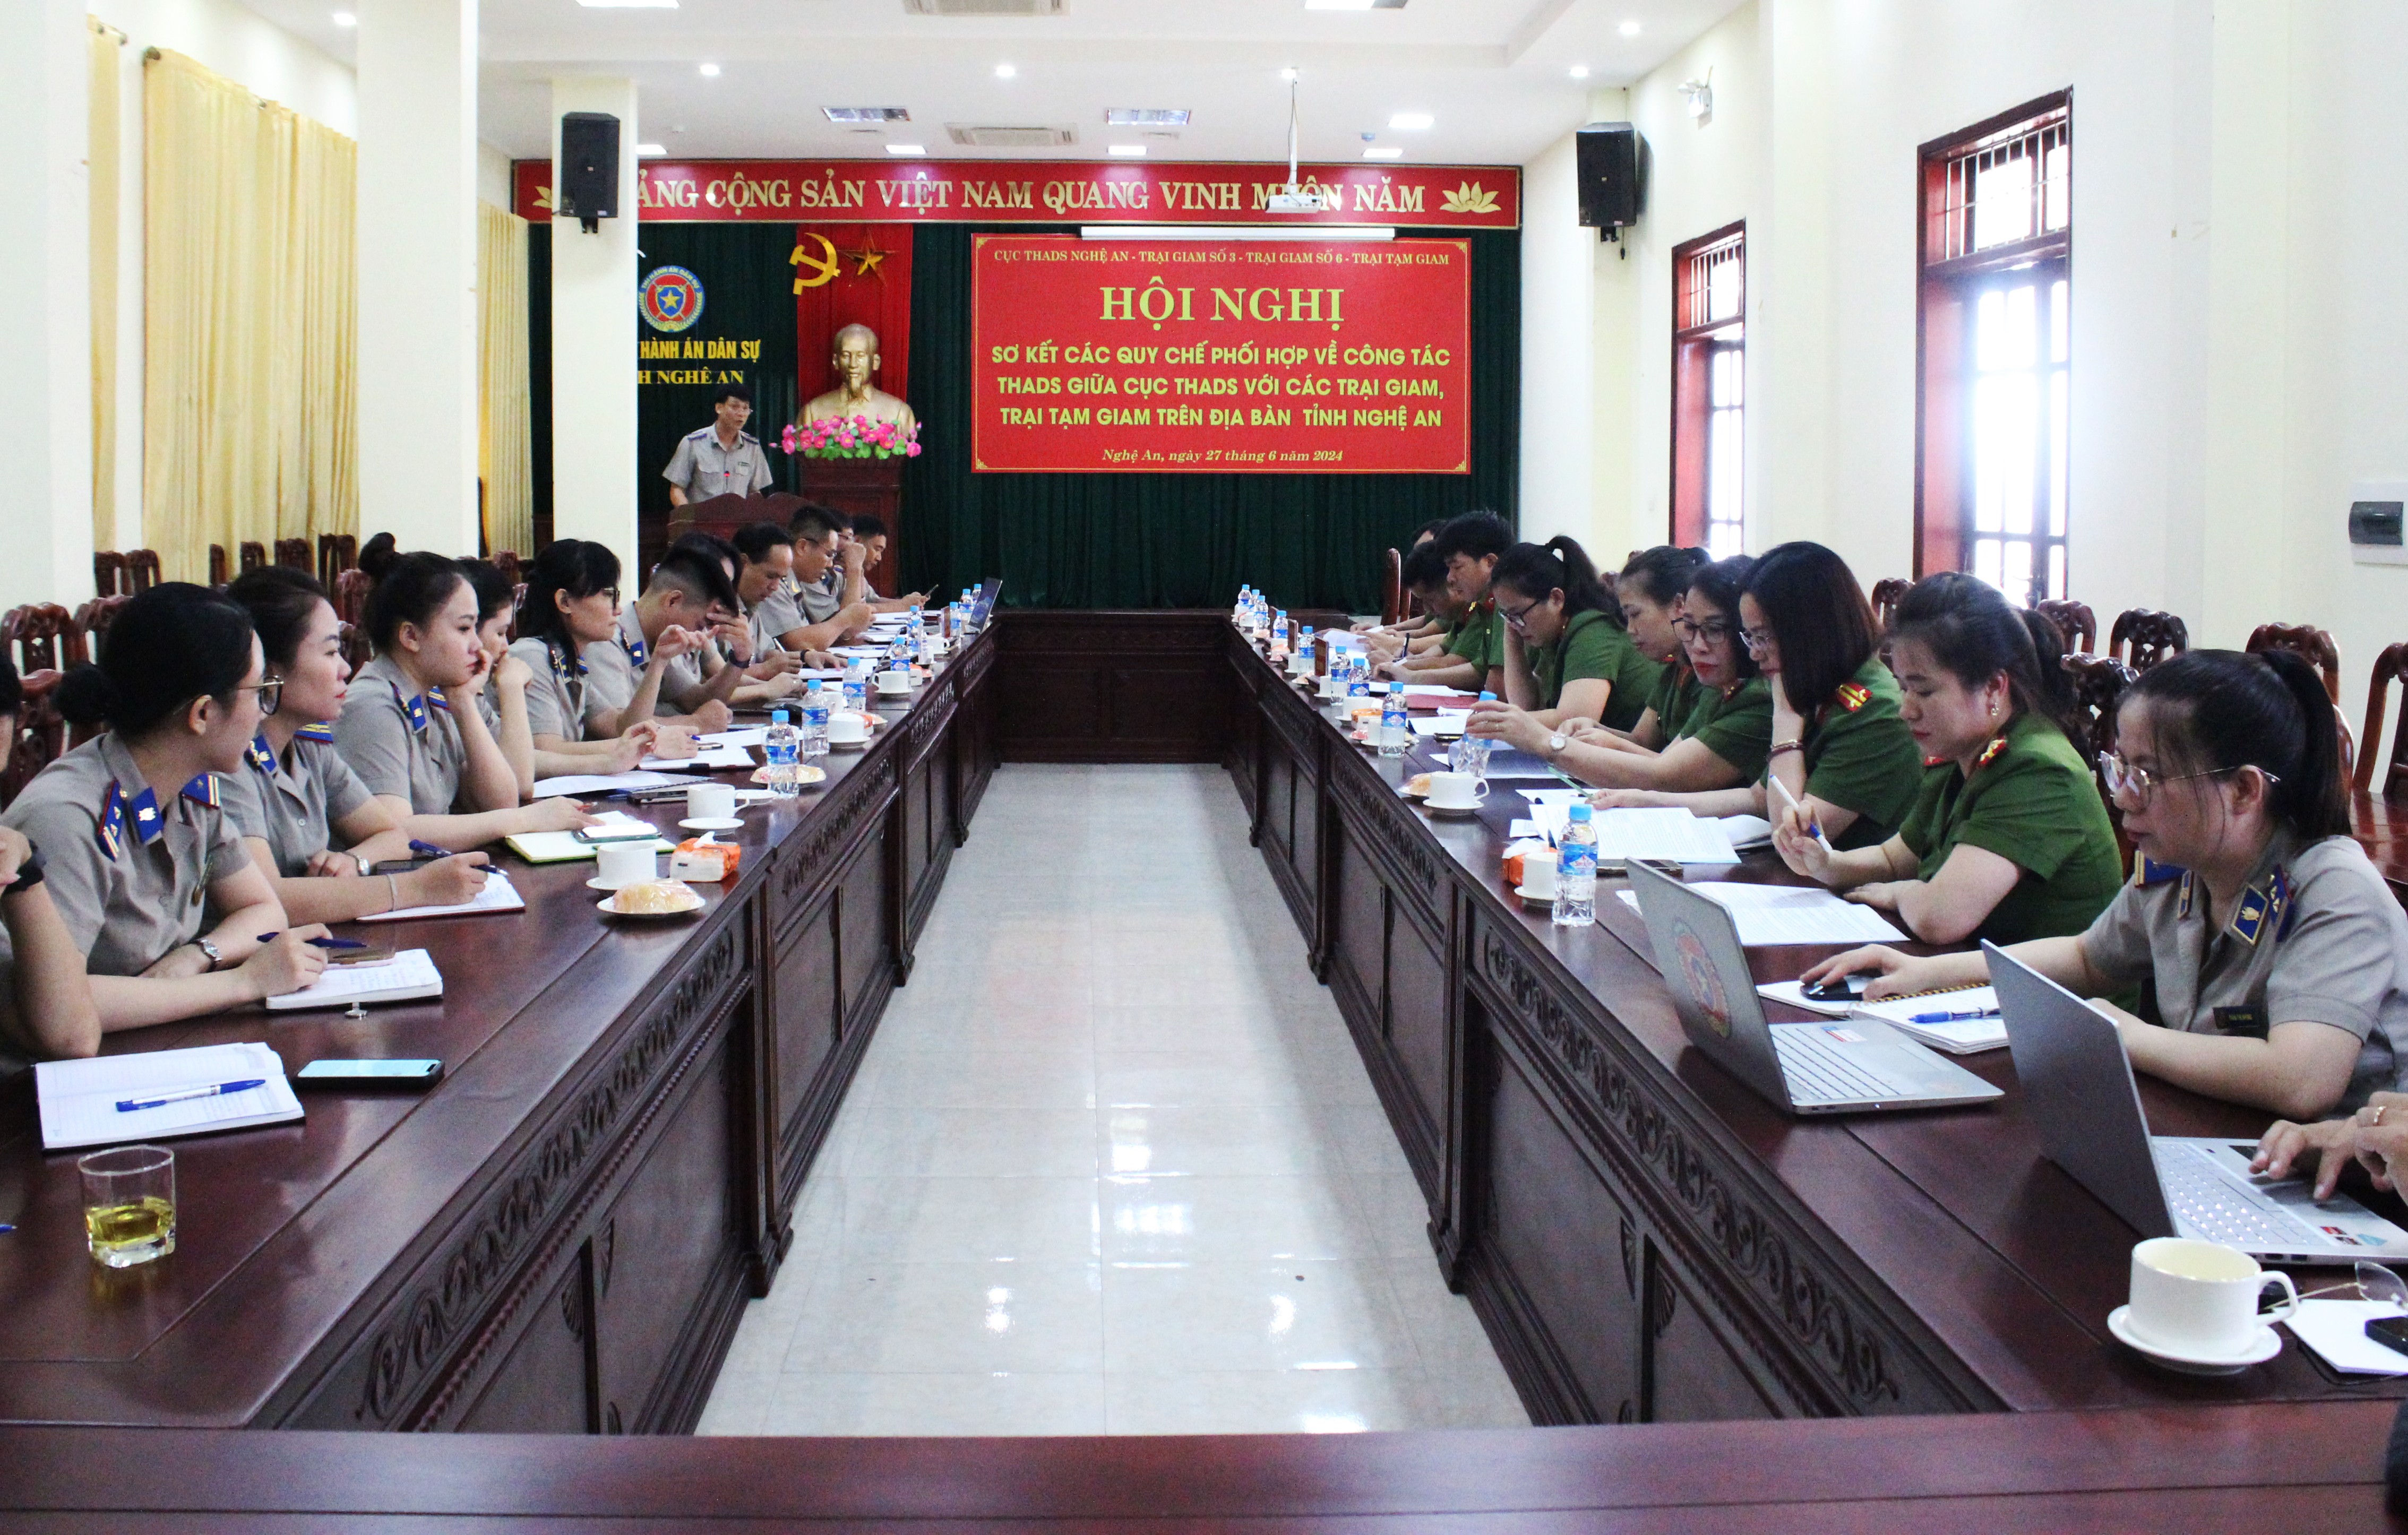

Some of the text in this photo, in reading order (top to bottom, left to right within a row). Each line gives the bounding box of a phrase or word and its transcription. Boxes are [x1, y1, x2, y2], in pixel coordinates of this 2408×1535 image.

[706, 171, 792, 215] CỘNG
[801, 168, 866, 208] SẢN
[876, 171, 953, 215] VIỆT
[961, 181, 1034, 209] NAM
[1043, 180, 1151, 215] QUANG
[1158, 182, 1242, 210] VINH
[1353, 176, 1426, 212] NĂM
[994, 250, 1021, 263] CỤC
[1024, 249, 1068, 261] THADS
[1070, 247, 1108, 264] NGHỆ
[1110, 251, 1129, 262] AN
[1138, 251, 1169, 265] TRẠI
[1172, 251, 1207, 263] GIAM
[1209, 247, 1227, 262] SỐ
[1229, 252, 1236, 262] 3
[1245, 252, 1276, 265] TRẠI
[1279, 252, 1313, 264] GIAM
[1315, 248, 1334, 263] SỐ
[1336, 253, 1343, 264] 6
[1352, 252, 1383, 266] TRẠI
[1385, 253, 1413, 267] TẠM
[1416, 254, 1449, 265] GIAM
[1099, 275, 1345, 331] HỘI NGHỊ
[640, 337, 761, 363] HÀNH ÁN DÂN SỰ
[992, 339, 1450, 369] SƠ KẾT CÁC QUY CHẾ PHỐI HỢP VỀ CÔNG TÁC
[717, 370, 743, 384] AN
[997, 373, 1444, 401] THADS GIỮA CỤC THADS VỚI CÁC TRẠI GIAM,
[1000, 403, 1442, 431] TRẠI TẠM GIAM TRÊN ĐỊA BÀN TỈNH NGHỆ AN
[1102, 449, 1343, 463] Nghệ An, ngày 27 tháng 6 năm 2024
